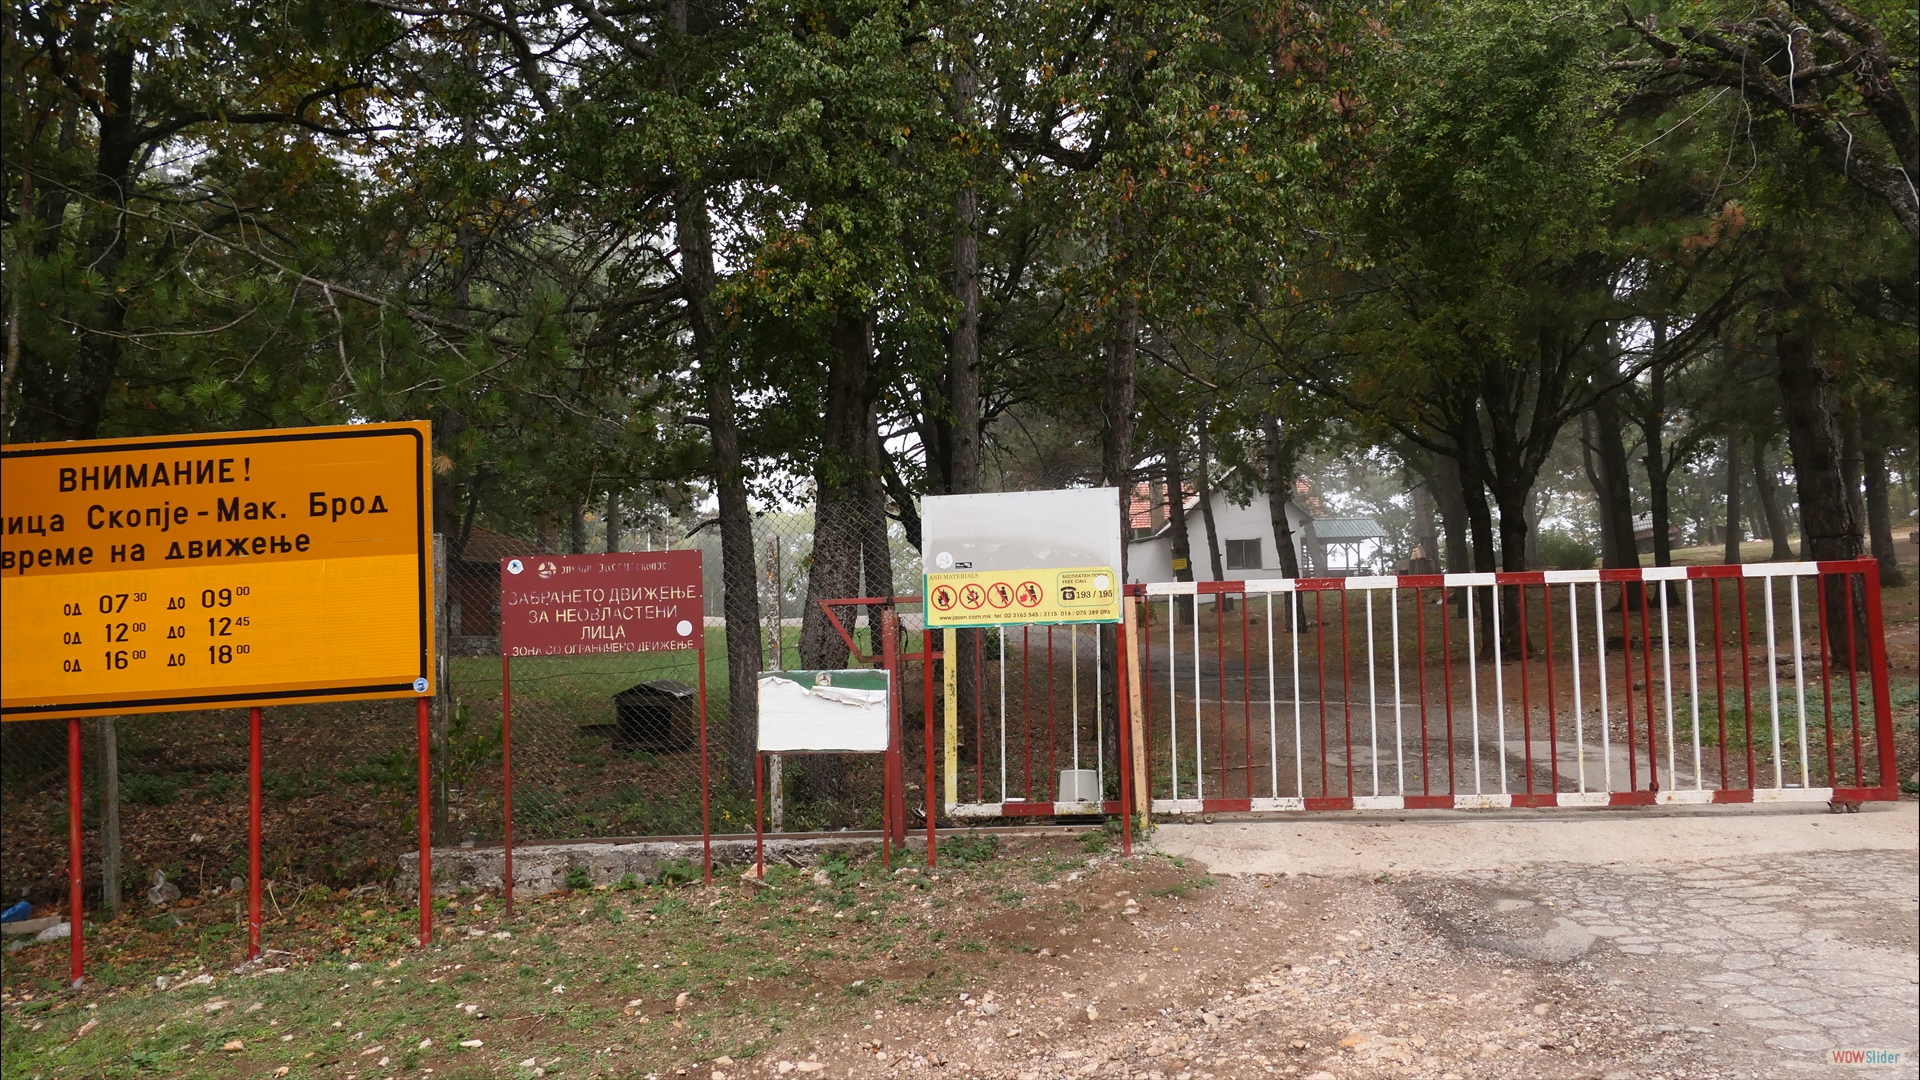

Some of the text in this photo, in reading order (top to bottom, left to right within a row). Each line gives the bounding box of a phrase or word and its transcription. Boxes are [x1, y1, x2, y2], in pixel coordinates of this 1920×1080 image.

[87, 501, 188, 533] Скопје
[217, 496, 287, 522] Мак.
[309, 491, 388, 523] Брод
[1, 532, 310, 575] време на движење
[508, 584, 696, 606] ЗАБРАНЕТО ДВИЖЕЊЕ
[1076, 591, 1091, 599] 193
[1099, 590, 1113, 598] 195
[528, 604, 678, 623] ЗА НЕОВЛАСТЕНИ
[581, 625, 626, 640] ЛИЦА
[512, 646, 541, 656] ЗОНА
[546, 645, 561, 655] СО
[637, 639, 693, 652] ДВИЖЕЊЕ
